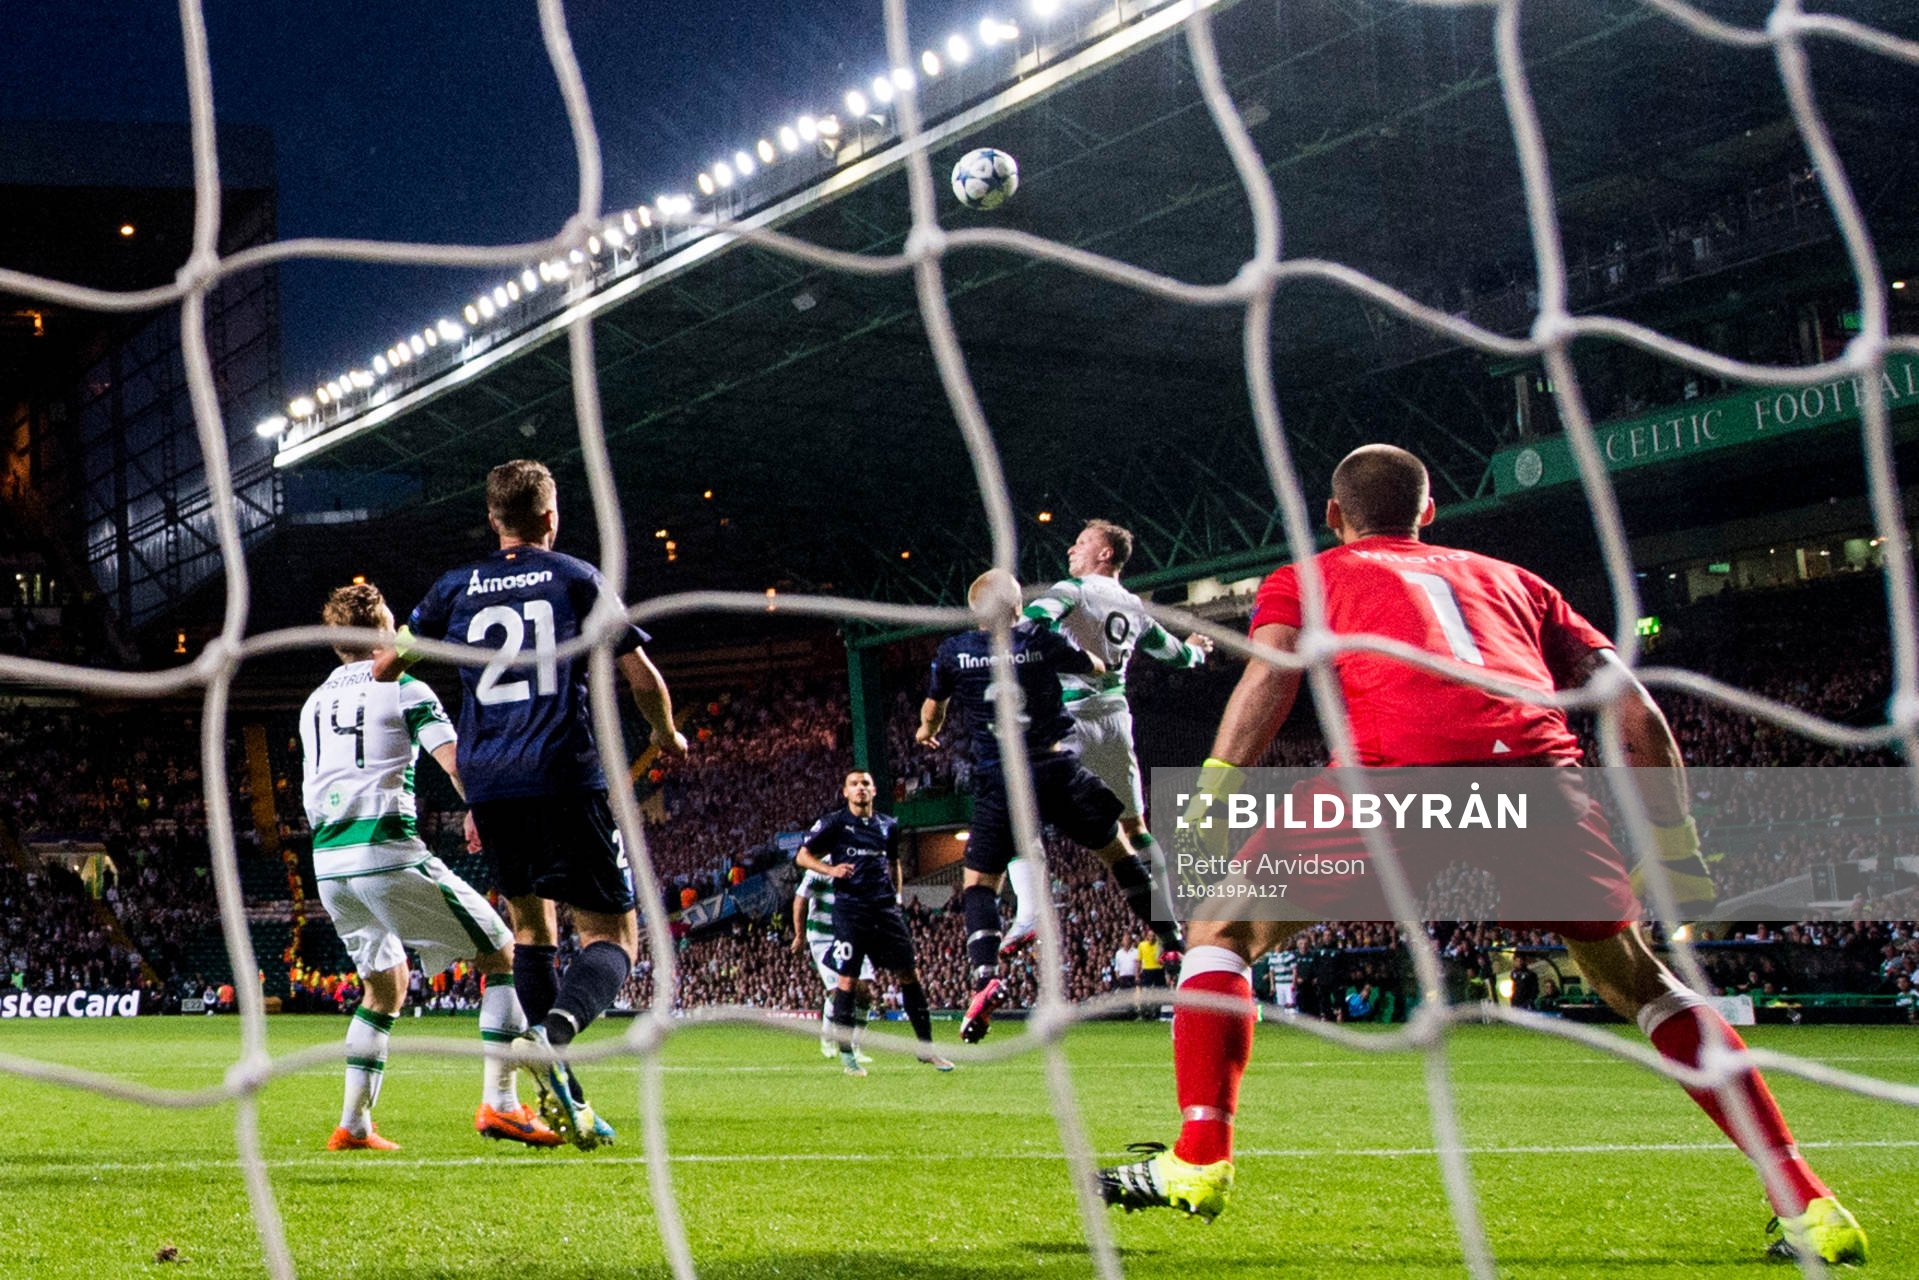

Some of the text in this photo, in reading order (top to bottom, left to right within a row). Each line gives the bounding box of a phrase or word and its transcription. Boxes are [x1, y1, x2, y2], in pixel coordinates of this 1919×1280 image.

[1605, 409, 1722, 463] CELTIC
[1400, 571, 1485, 666] 1
[467, 600, 558, 706] 21
[957, 649, 1044, 669] Tinneholm
[314, 699, 365, 774] 14
[833, 940, 853, 961] 20
[0, 989, 141, 1018] sterCard
